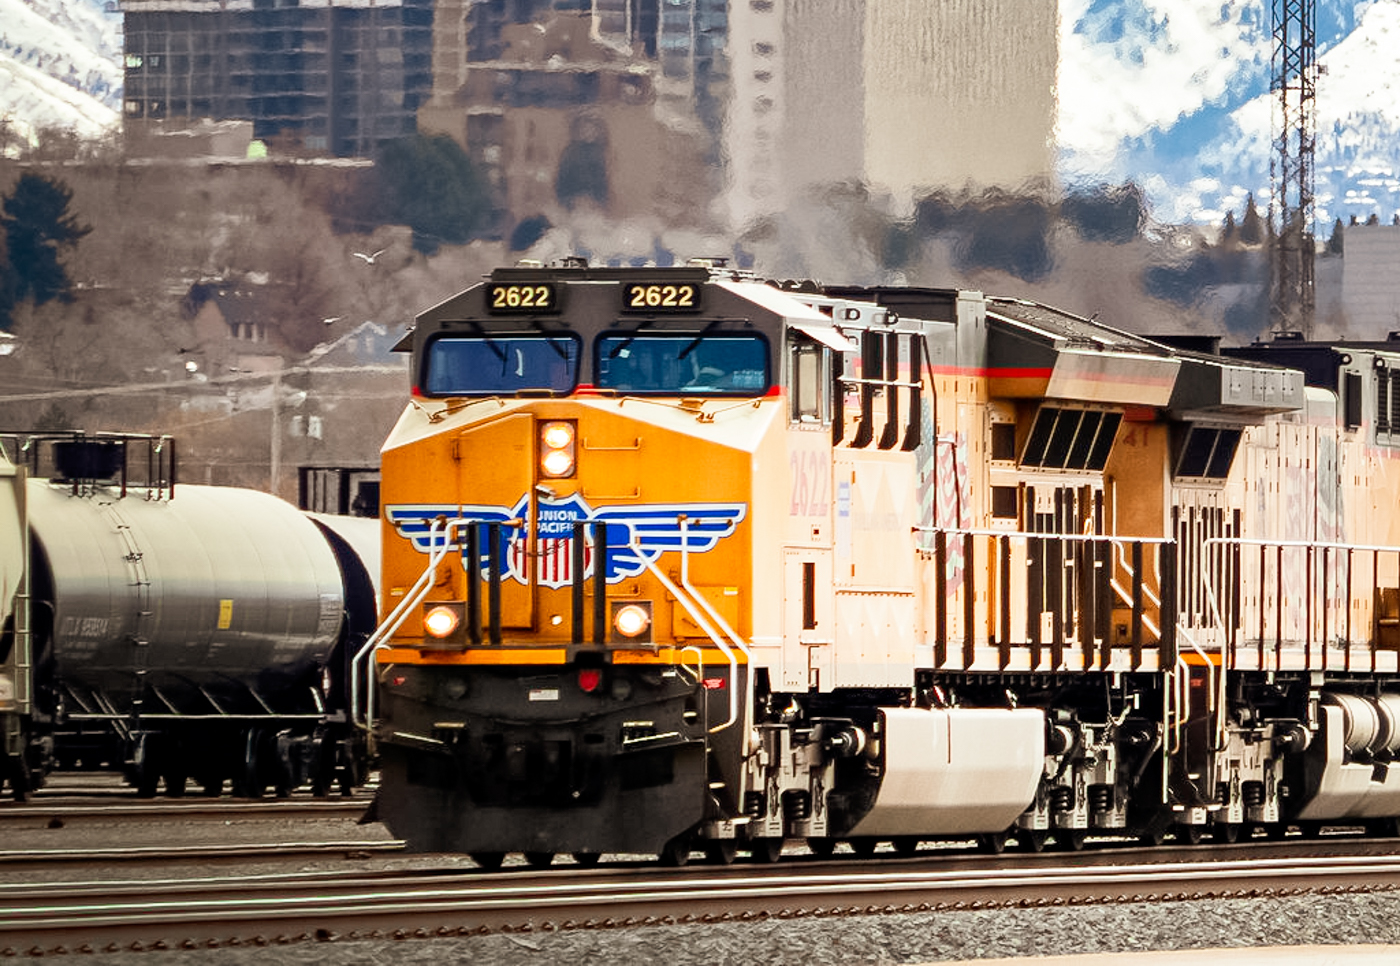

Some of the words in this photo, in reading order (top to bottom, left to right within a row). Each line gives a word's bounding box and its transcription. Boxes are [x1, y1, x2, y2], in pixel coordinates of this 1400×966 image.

[493, 286, 549, 307] 2622
[630, 286, 694, 307] 2622
[789, 450, 829, 517] 2622
[524, 510, 577, 521] UNION
